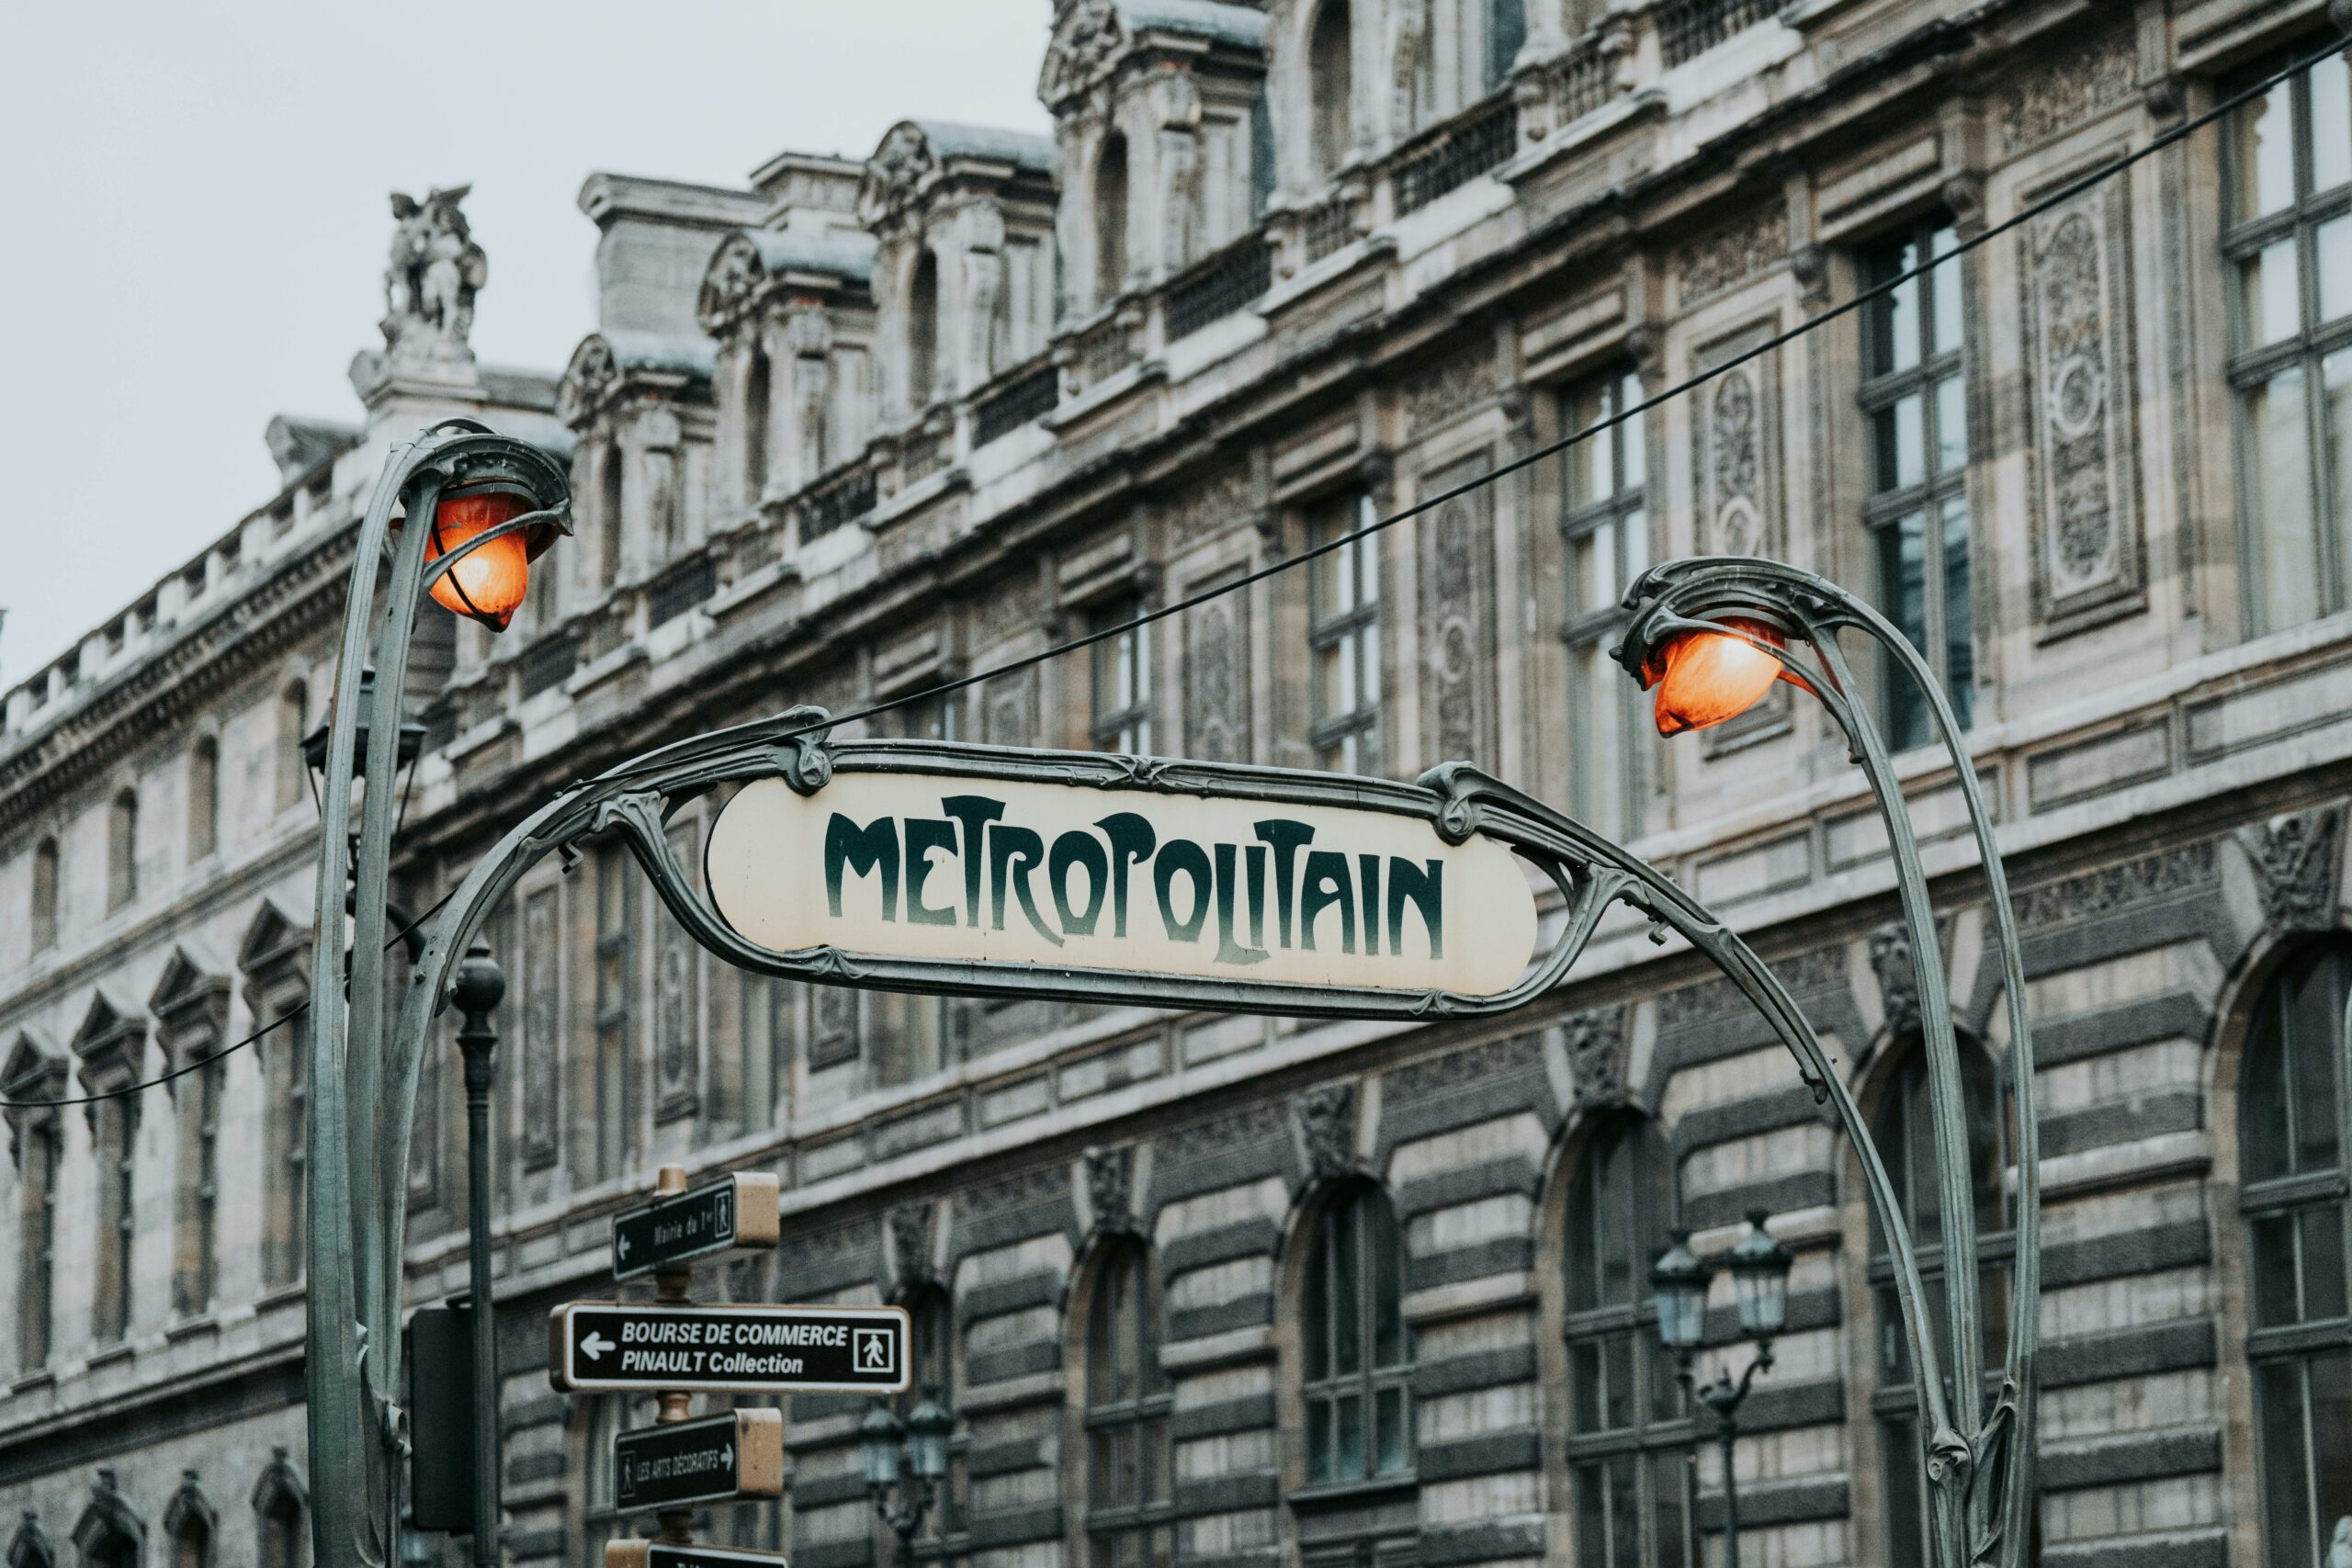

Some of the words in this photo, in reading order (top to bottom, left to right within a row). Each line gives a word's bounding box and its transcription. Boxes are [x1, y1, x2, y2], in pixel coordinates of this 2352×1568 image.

[824, 795, 1444, 964] METROPOLITAIN
[654, 1220, 683, 1246] Mairie
[686, 1214, 697, 1235] du
[621, 1322, 702, 1344] BOURSE
[705, 1324, 732, 1344] DE
[735, 1324, 848, 1347] COMMERCE
[621, 1350, 707, 1372] PINAULT
[709, 1352, 804, 1374] Collection
[637, 1461, 650, 1483] LES
[652, 1456, 671, 1478] ARTS
[673, 1449, 719, 1476] DÉCORATIFS
